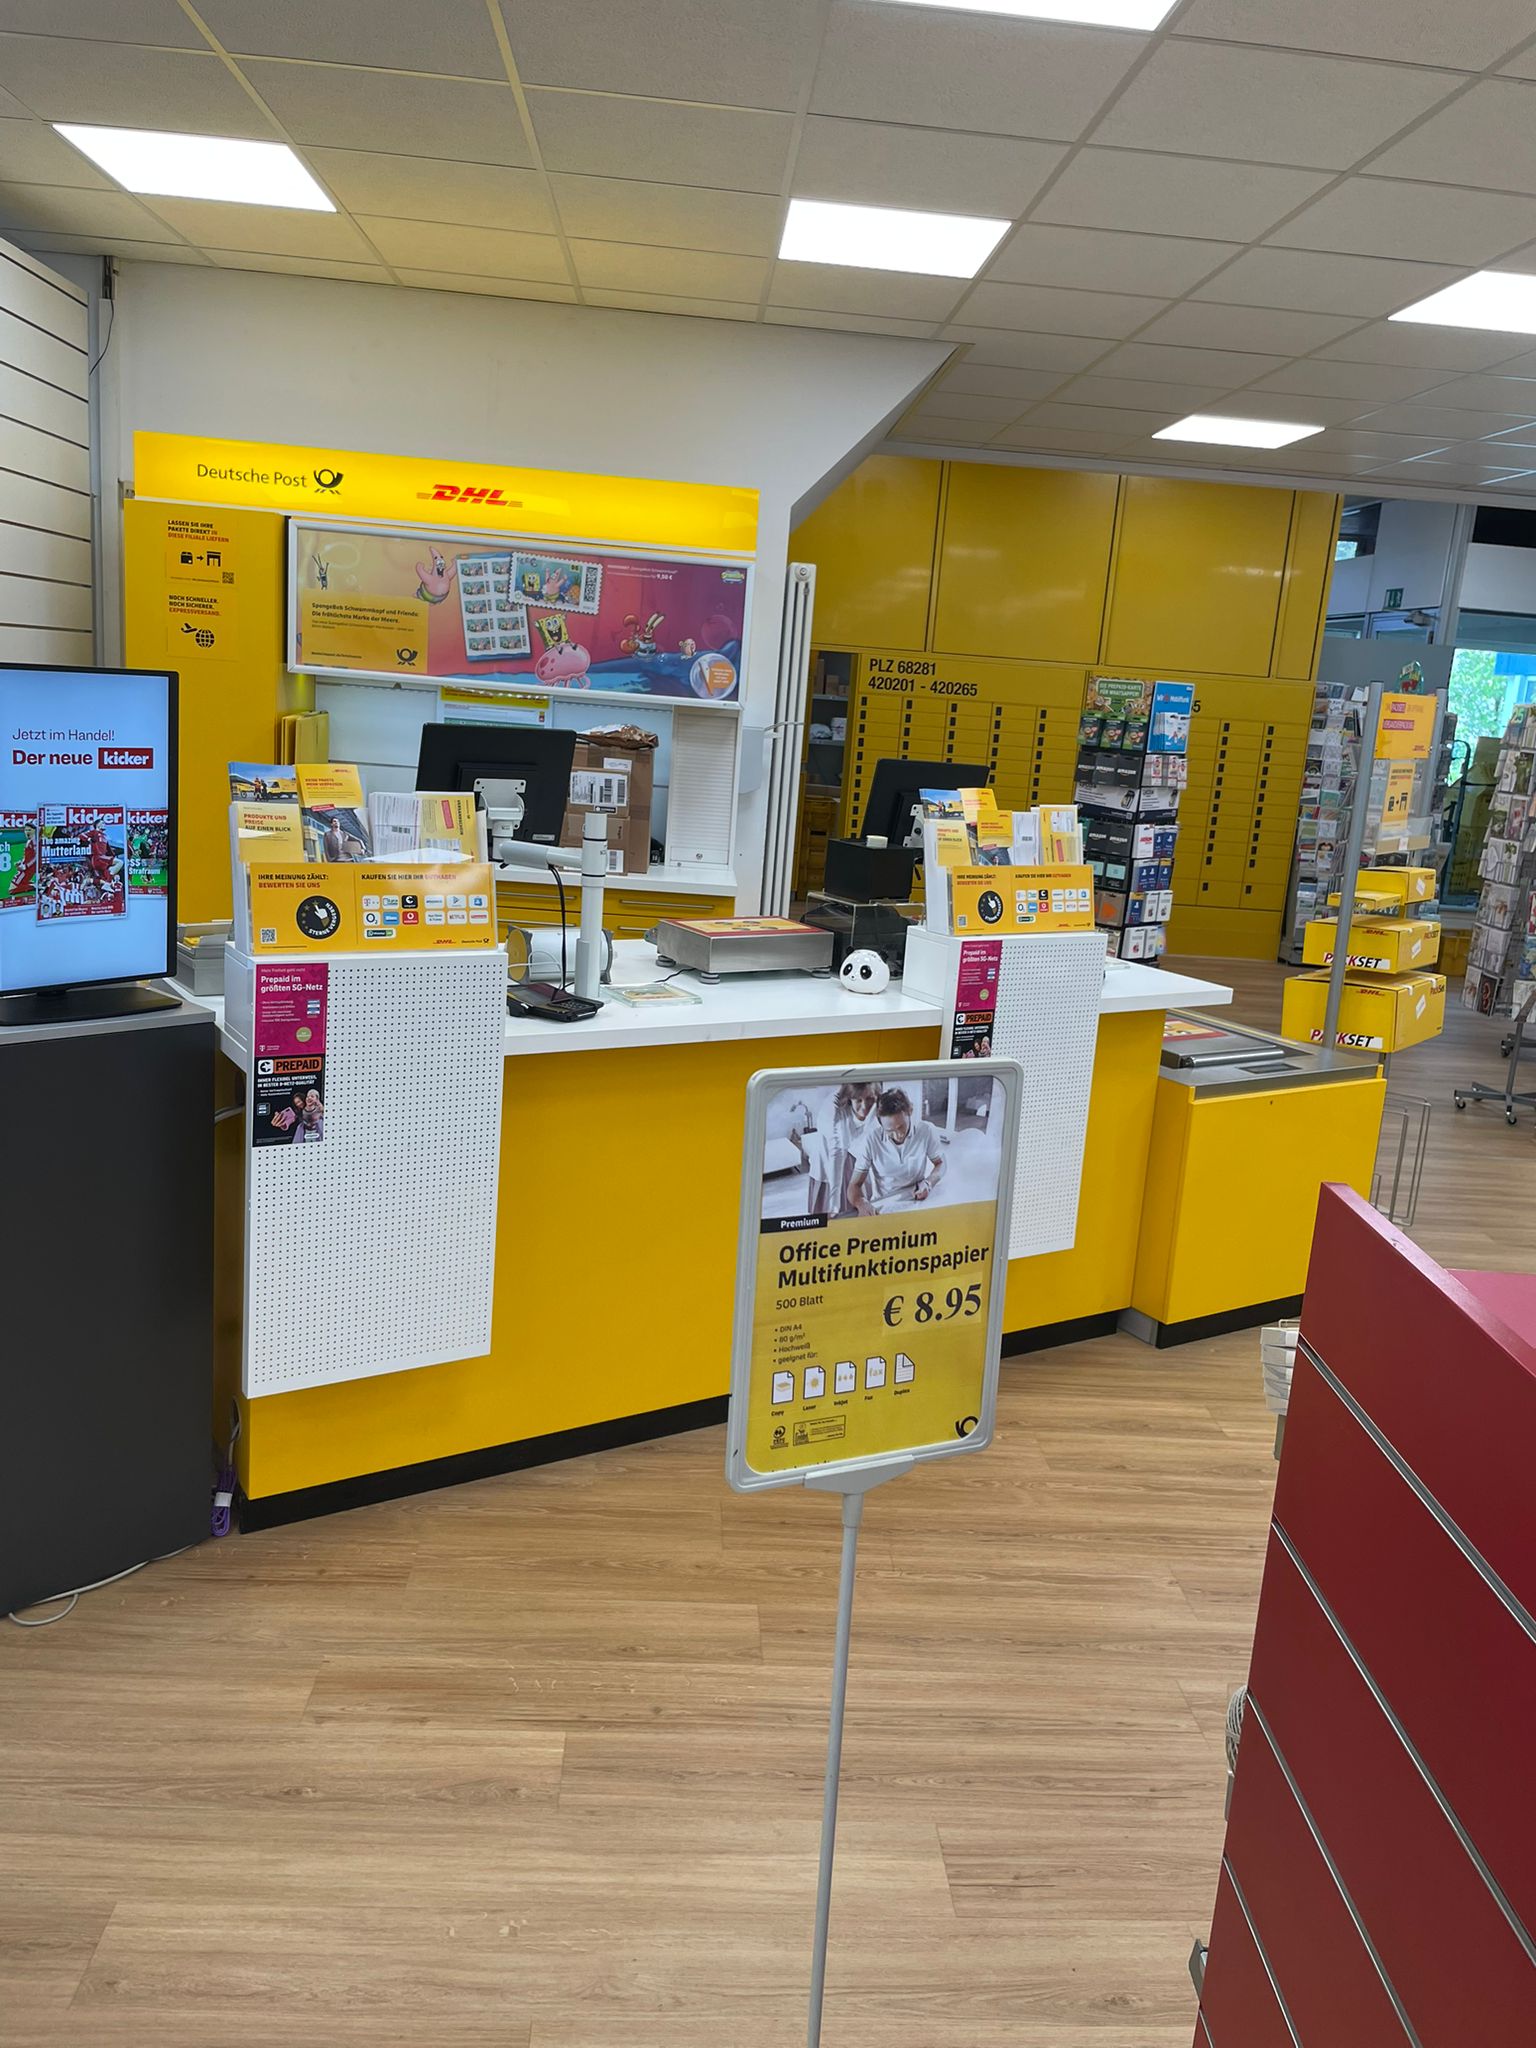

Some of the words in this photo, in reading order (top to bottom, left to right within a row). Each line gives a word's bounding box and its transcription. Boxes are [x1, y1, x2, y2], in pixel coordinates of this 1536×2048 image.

[197, 463, 270, 484] Deutsche
[273, 471, 308, 488] Post
[431, 484, 509, 506] DHL
[344, 606, 385, 616] Schwammkopf
[352, 614, 370, 622] Marke
[869, 658, 893, 673] PLZ
[897, 661, 936, 676] 68281
[868, 676, 915, 692] 420201
[930, 681, 978, 697] 420265
[12, 728, 46, 741] Jetzt
[49, 729, 65, 741] im
[68, 729, 115, 741] Handel!
[12, 750, 46, 765] Der
[49, 753, 93, 765] neue
[103, 751, 149, 765] kicker
[68, 808, 122, 824] kicker
[127, 812, 168, 824] kicker
[42, 844, 92, 857] Mutterland
[306, 872, 329, 880] ZÄHLT:
[326, 902, 338, 932] VERGEBEN
[308, 927, 331, 936] STERNE
[1323, 952, 1382, 969] PKSET
[260, 975, 290, 984] Prepaid
[260, 984, 291, 994] größten
[966, 1012, 992, 1023] PREPAID
[1310, 1029, 1374, 1048] PKSET
[275, 1059, 320, 1071] PREPAID
[780, 1217, 820, 1229] Premium
[779, 1242, 841, 1264] Office
[847, 1230, 938, 1256] Premium
[778, 1244, 990, 1289] Multifunktionspapier
[776, 1298, 797, 1310] 500
[799, 1295, 824, 1306] Blatt
[882, 1295, 905, 1328] €
[914, 1283, 982, 1324] 8.95
[780, 1325, 792, 1333] DIN
[790, 1332, 806, 1343] g/m²
[778, 1342, 810, 1353] Hochweiß
[778, 1354, 806, 1364] geeignet
[869, 1368, 883, 1377] fax
